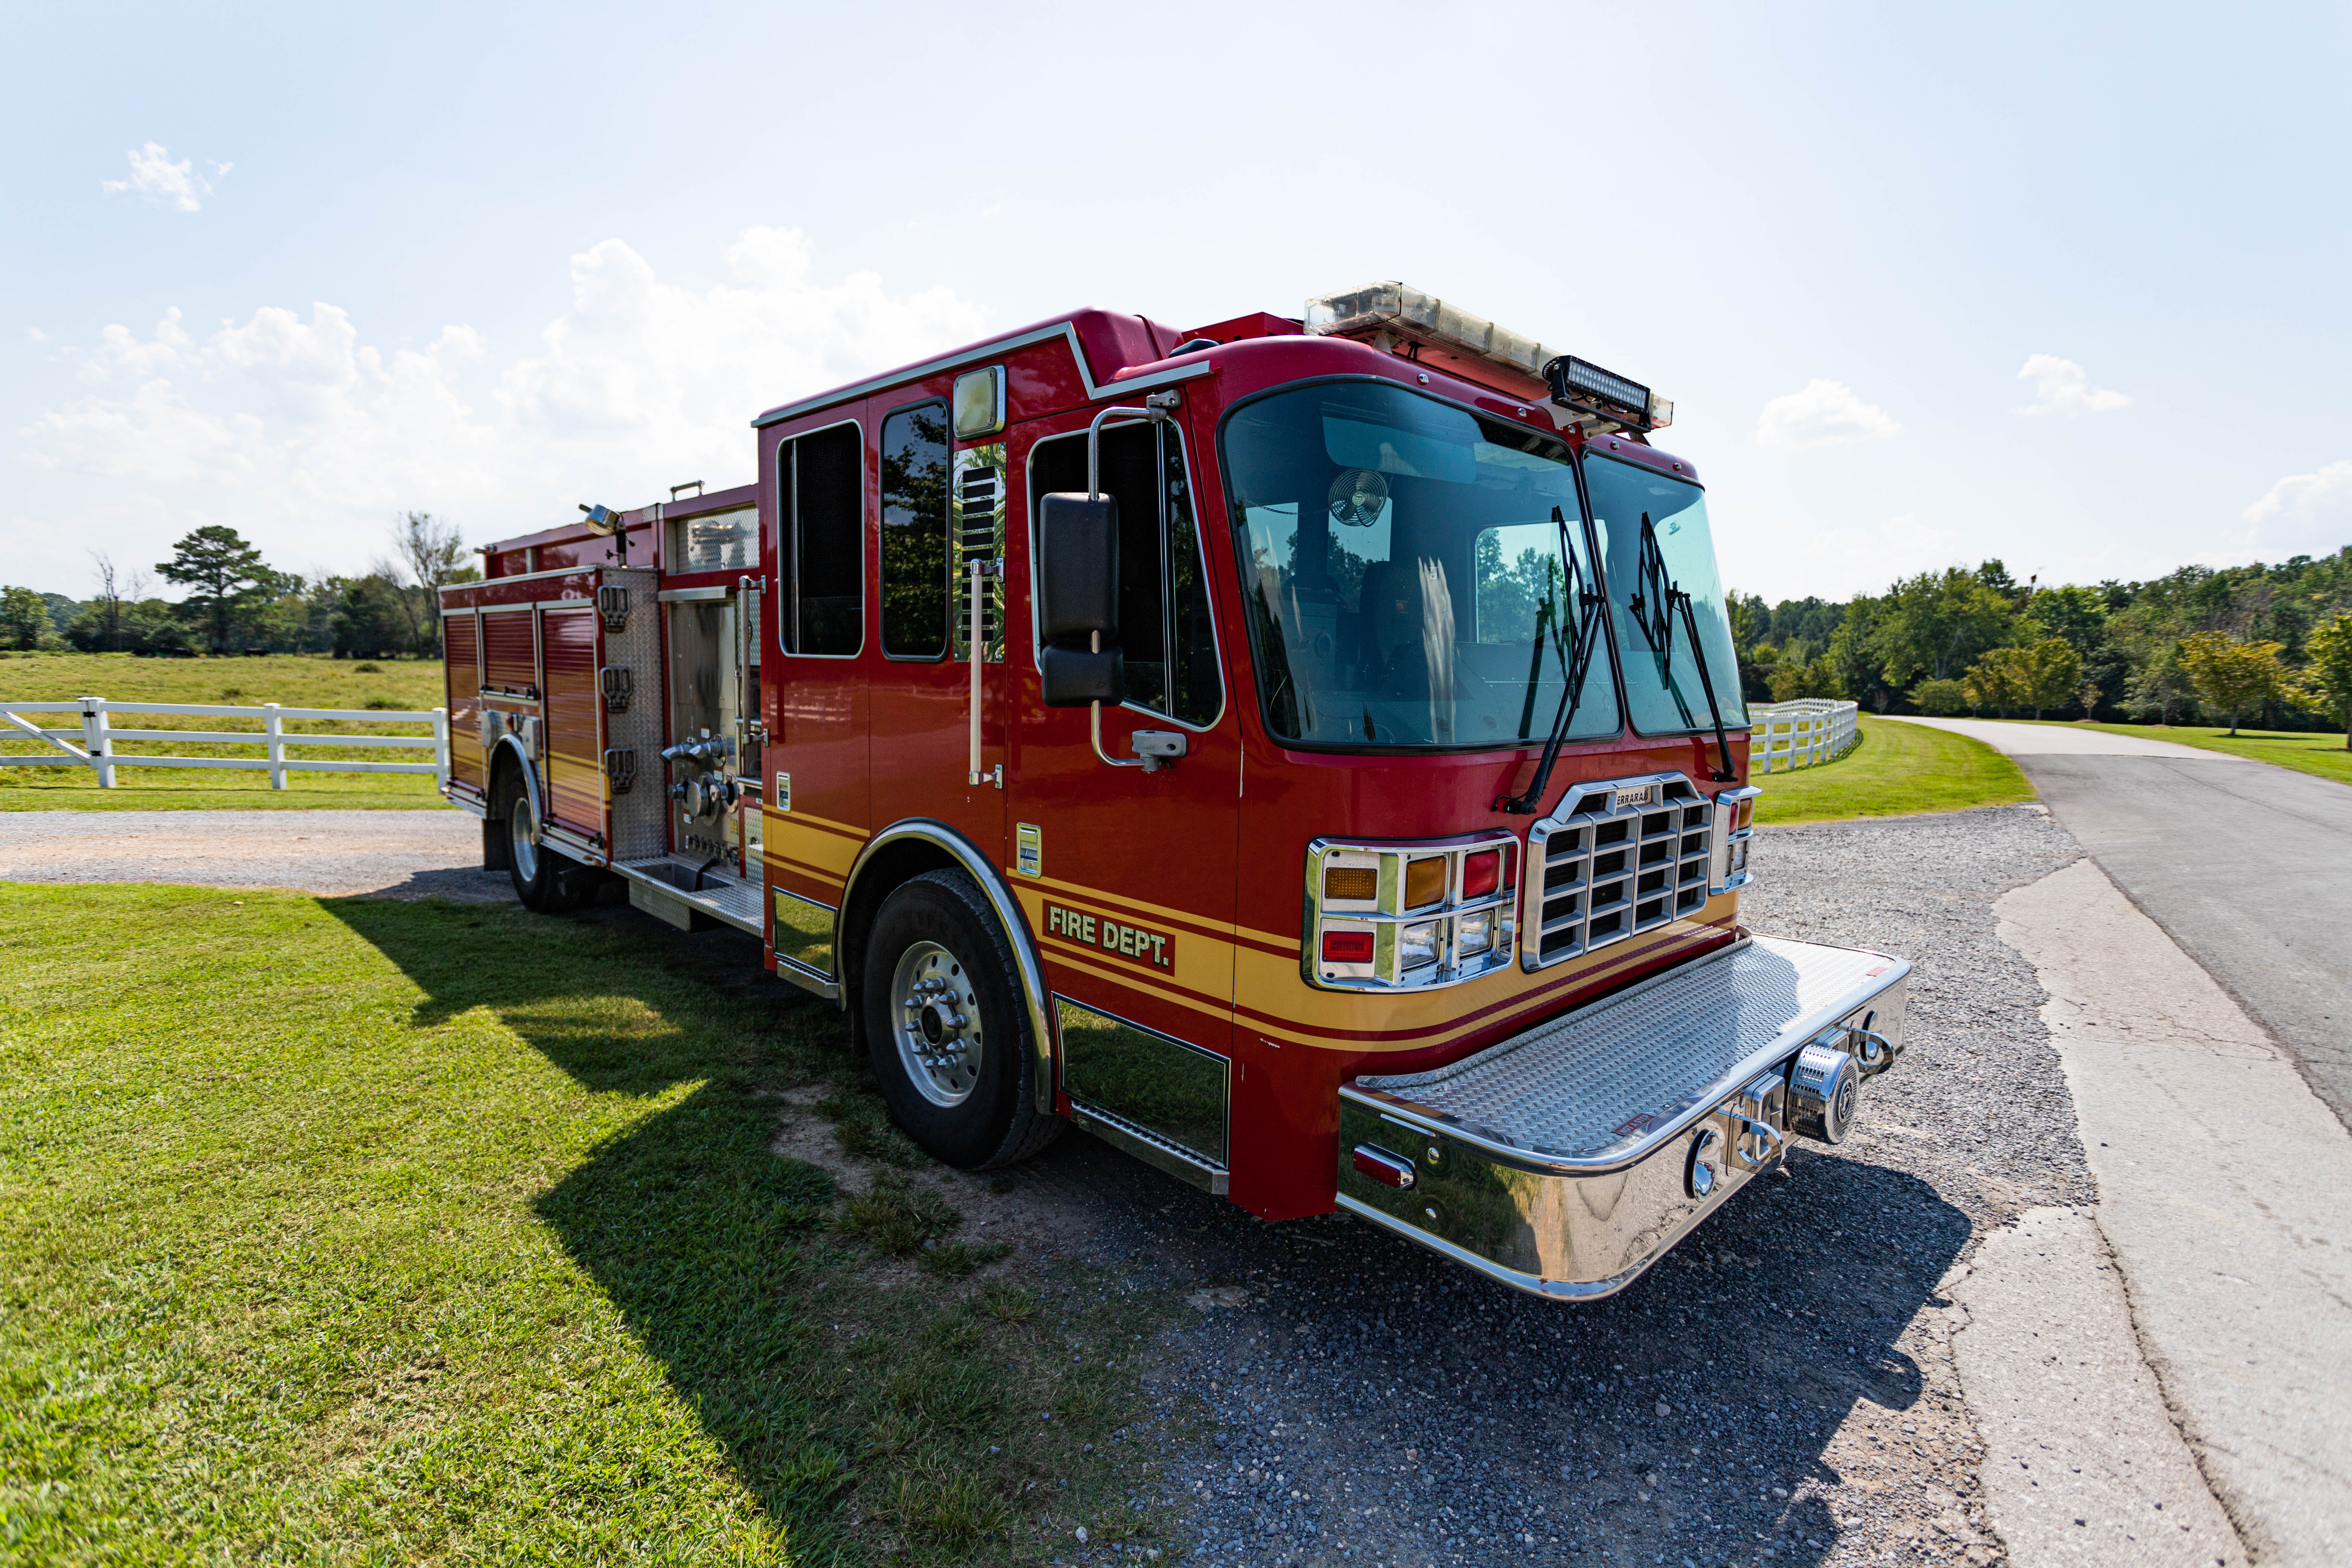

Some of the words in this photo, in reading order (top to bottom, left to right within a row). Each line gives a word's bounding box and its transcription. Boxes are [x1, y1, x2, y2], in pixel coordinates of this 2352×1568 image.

[1617, 792, 1643, 805] ERRARA
[1049, 906, 1095, 945] FIRE
[1102, 921, 1168, 968] DEPT.
[1618, 1125, 1634, 1133] NOT
[1634, 1115, 1649, 1124] STEP
